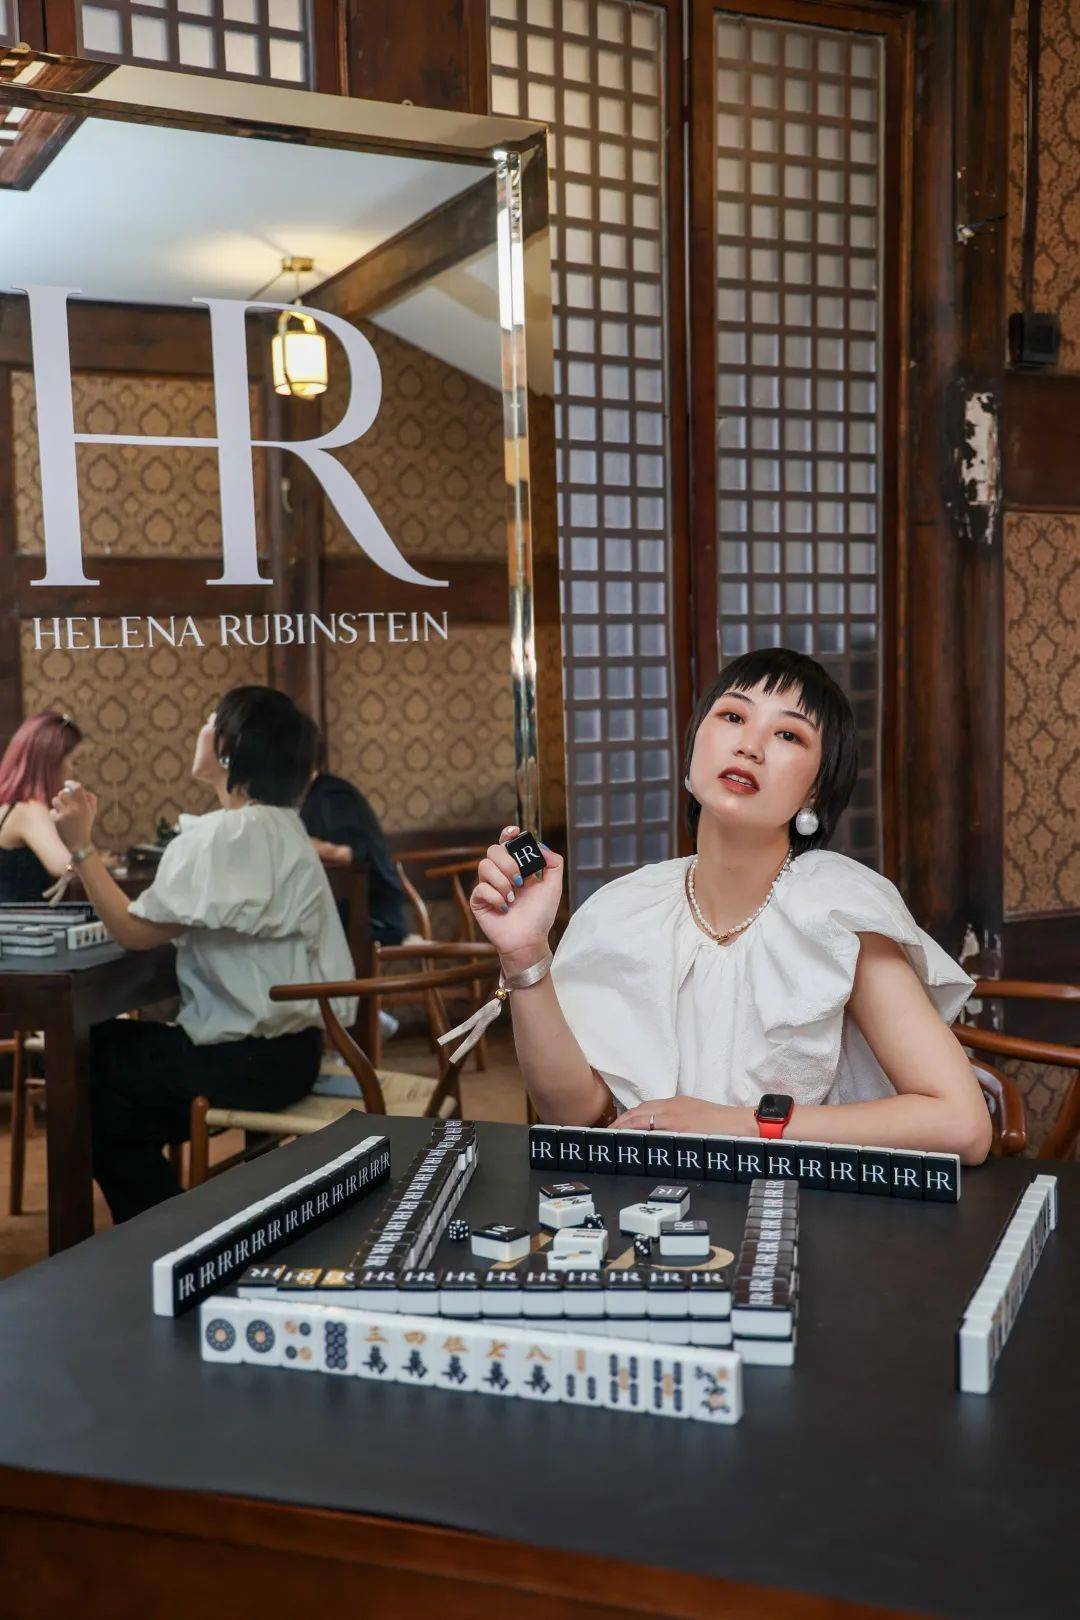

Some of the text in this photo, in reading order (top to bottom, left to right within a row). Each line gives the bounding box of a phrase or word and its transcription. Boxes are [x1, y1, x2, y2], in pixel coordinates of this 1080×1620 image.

[11, 284, 449, 587] HR
[33, 611, 450, 649] HELENA RUBINSTEIN
[513, 846, 540, 867] HR
[532, 1141, 953, 1191] HR HR HR HR HR HR HR HR HR HR HR HR HR HR
[553, 1183, 576, 1192] HR
[179, 1152, 390, 1300] HR HR HR HR HR HR HR HR HR HR HR HR HR HR
[364, 1272, 395, 1281] HR
[404, 1272, 436, 1281] HR
[446, 1272, 476, 1281] HR
[486, 1272, 518, 1282] HR
[527, 1272, 557, 1282] HR
[568, 1272, 600, 1282] HR
[610, 1272, 641, 1282] HR
[651, 1272, 683, 1282] HR
[691, 1272, 724, 1282] HR
